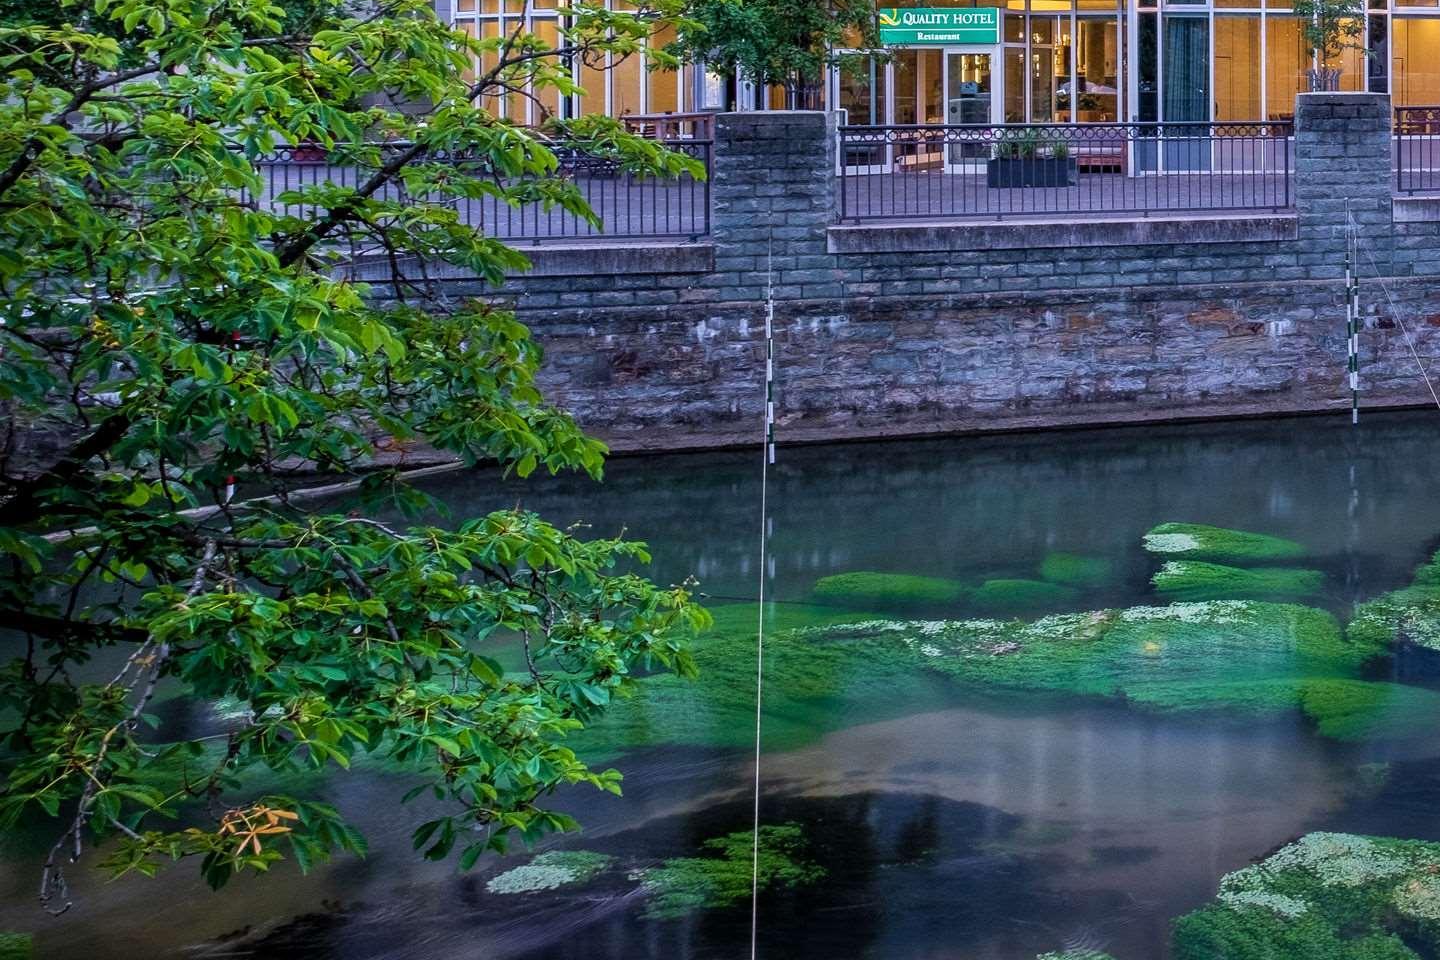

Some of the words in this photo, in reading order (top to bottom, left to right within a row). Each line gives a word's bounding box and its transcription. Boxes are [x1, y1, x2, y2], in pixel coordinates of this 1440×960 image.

[903, 12, 949, 25] QUALITY
[953, 13, 994, 24] HOTEL
[917, 32, 960, 40] Restaurant
